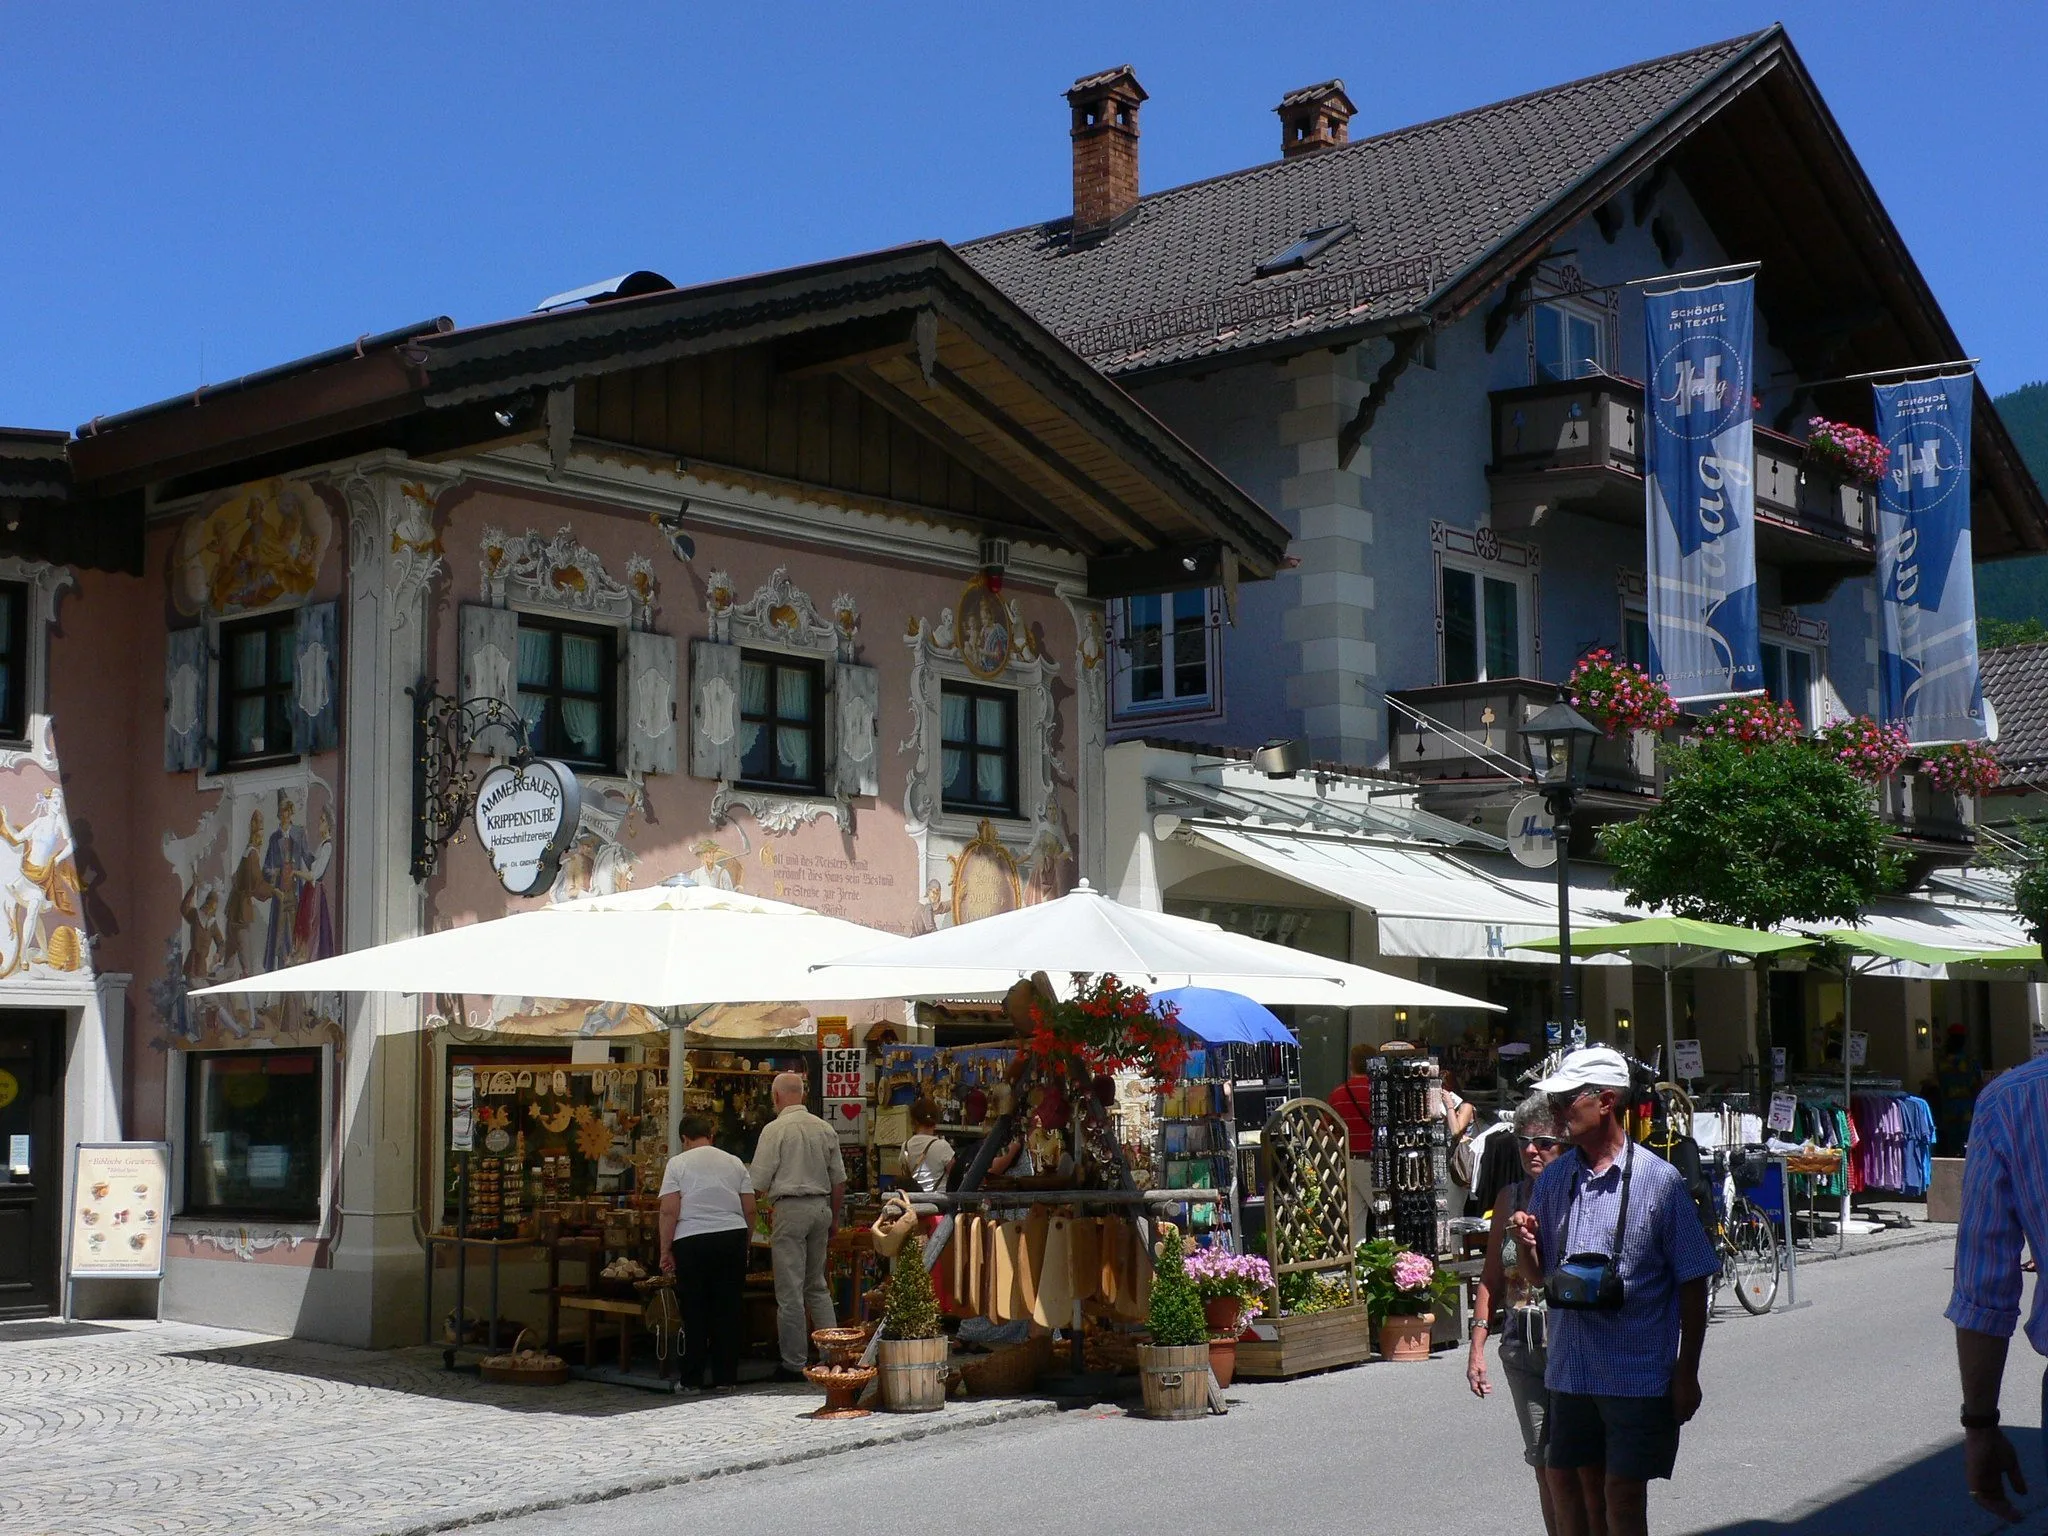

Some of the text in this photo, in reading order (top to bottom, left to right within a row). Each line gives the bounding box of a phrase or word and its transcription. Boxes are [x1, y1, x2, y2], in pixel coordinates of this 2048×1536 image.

[1670, 303, 1725, 319] SCHÖNES
[1669, 314, 1727, 331] IN TEXTIL
[1660, 365, 1728, 402] Haag
[1656, 663, 1757, 683] OBERAMMERGAU
[481, 775, 560, 818] AMMERGAUER
[487, 806, 556, 831] KRIPPENSTUBE
[491, 831, 553, 847] Holzschnitzereien
[826, 1049, 860, 1060] ICH
[826, 1061, 860, 1073] CHEF
[826, 1072, 861, 1084] DU
[826, 1084, 860, 1097] NIX
[828, 1104, 838, 1121] I
